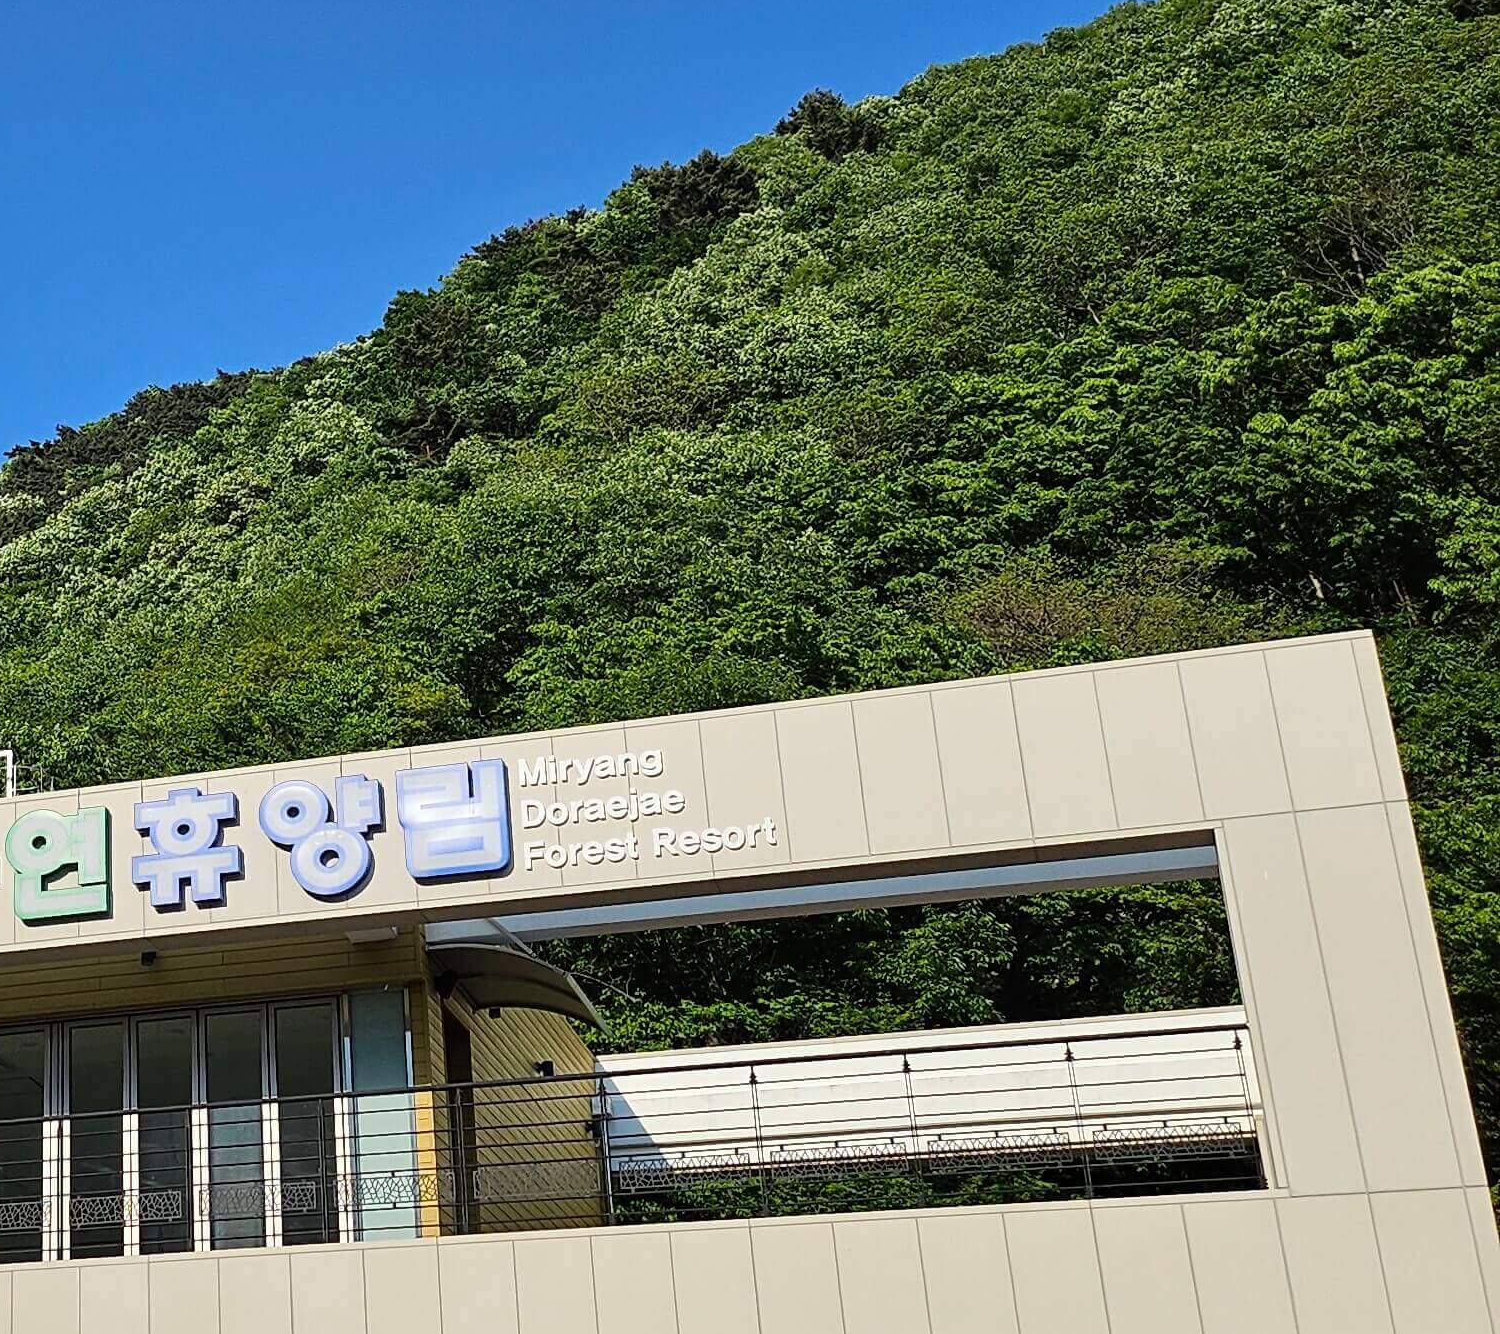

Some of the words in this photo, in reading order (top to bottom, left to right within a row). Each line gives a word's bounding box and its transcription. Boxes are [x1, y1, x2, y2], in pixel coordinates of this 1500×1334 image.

[518, 747, 664, 789] Miryang
[521, 789, 685, 830] Doraejae
[523, 829, 639, 871] Forest
[654, 816, 778, 858] Resort
